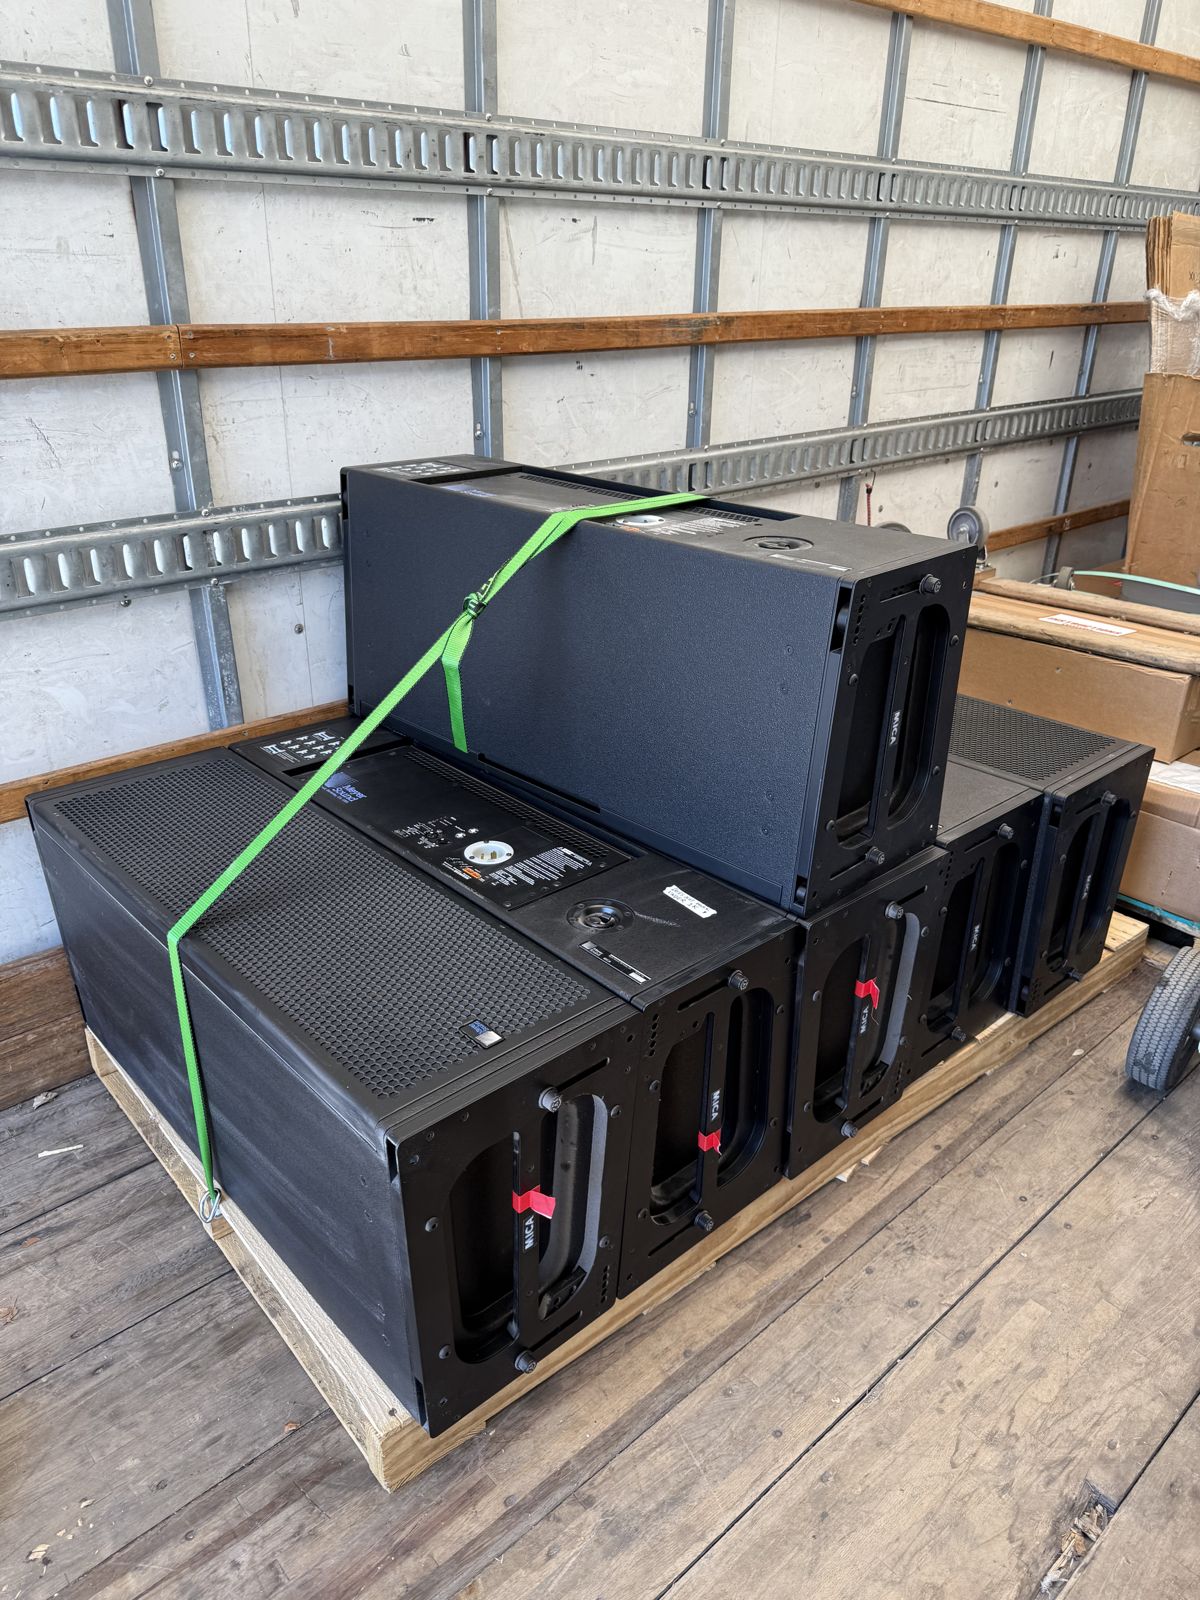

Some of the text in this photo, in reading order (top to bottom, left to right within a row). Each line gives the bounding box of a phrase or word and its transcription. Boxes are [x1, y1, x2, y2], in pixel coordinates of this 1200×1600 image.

[889, 710, 901, 746] MICA
[332, 787, 359, 802] Sound
[342, 784, 368, 799] Meyer
[859, 1005, 870, 1034] MICA
[711, 1088, 721, 1121] MICA
[524, 1215, 535, 1250] MICA
